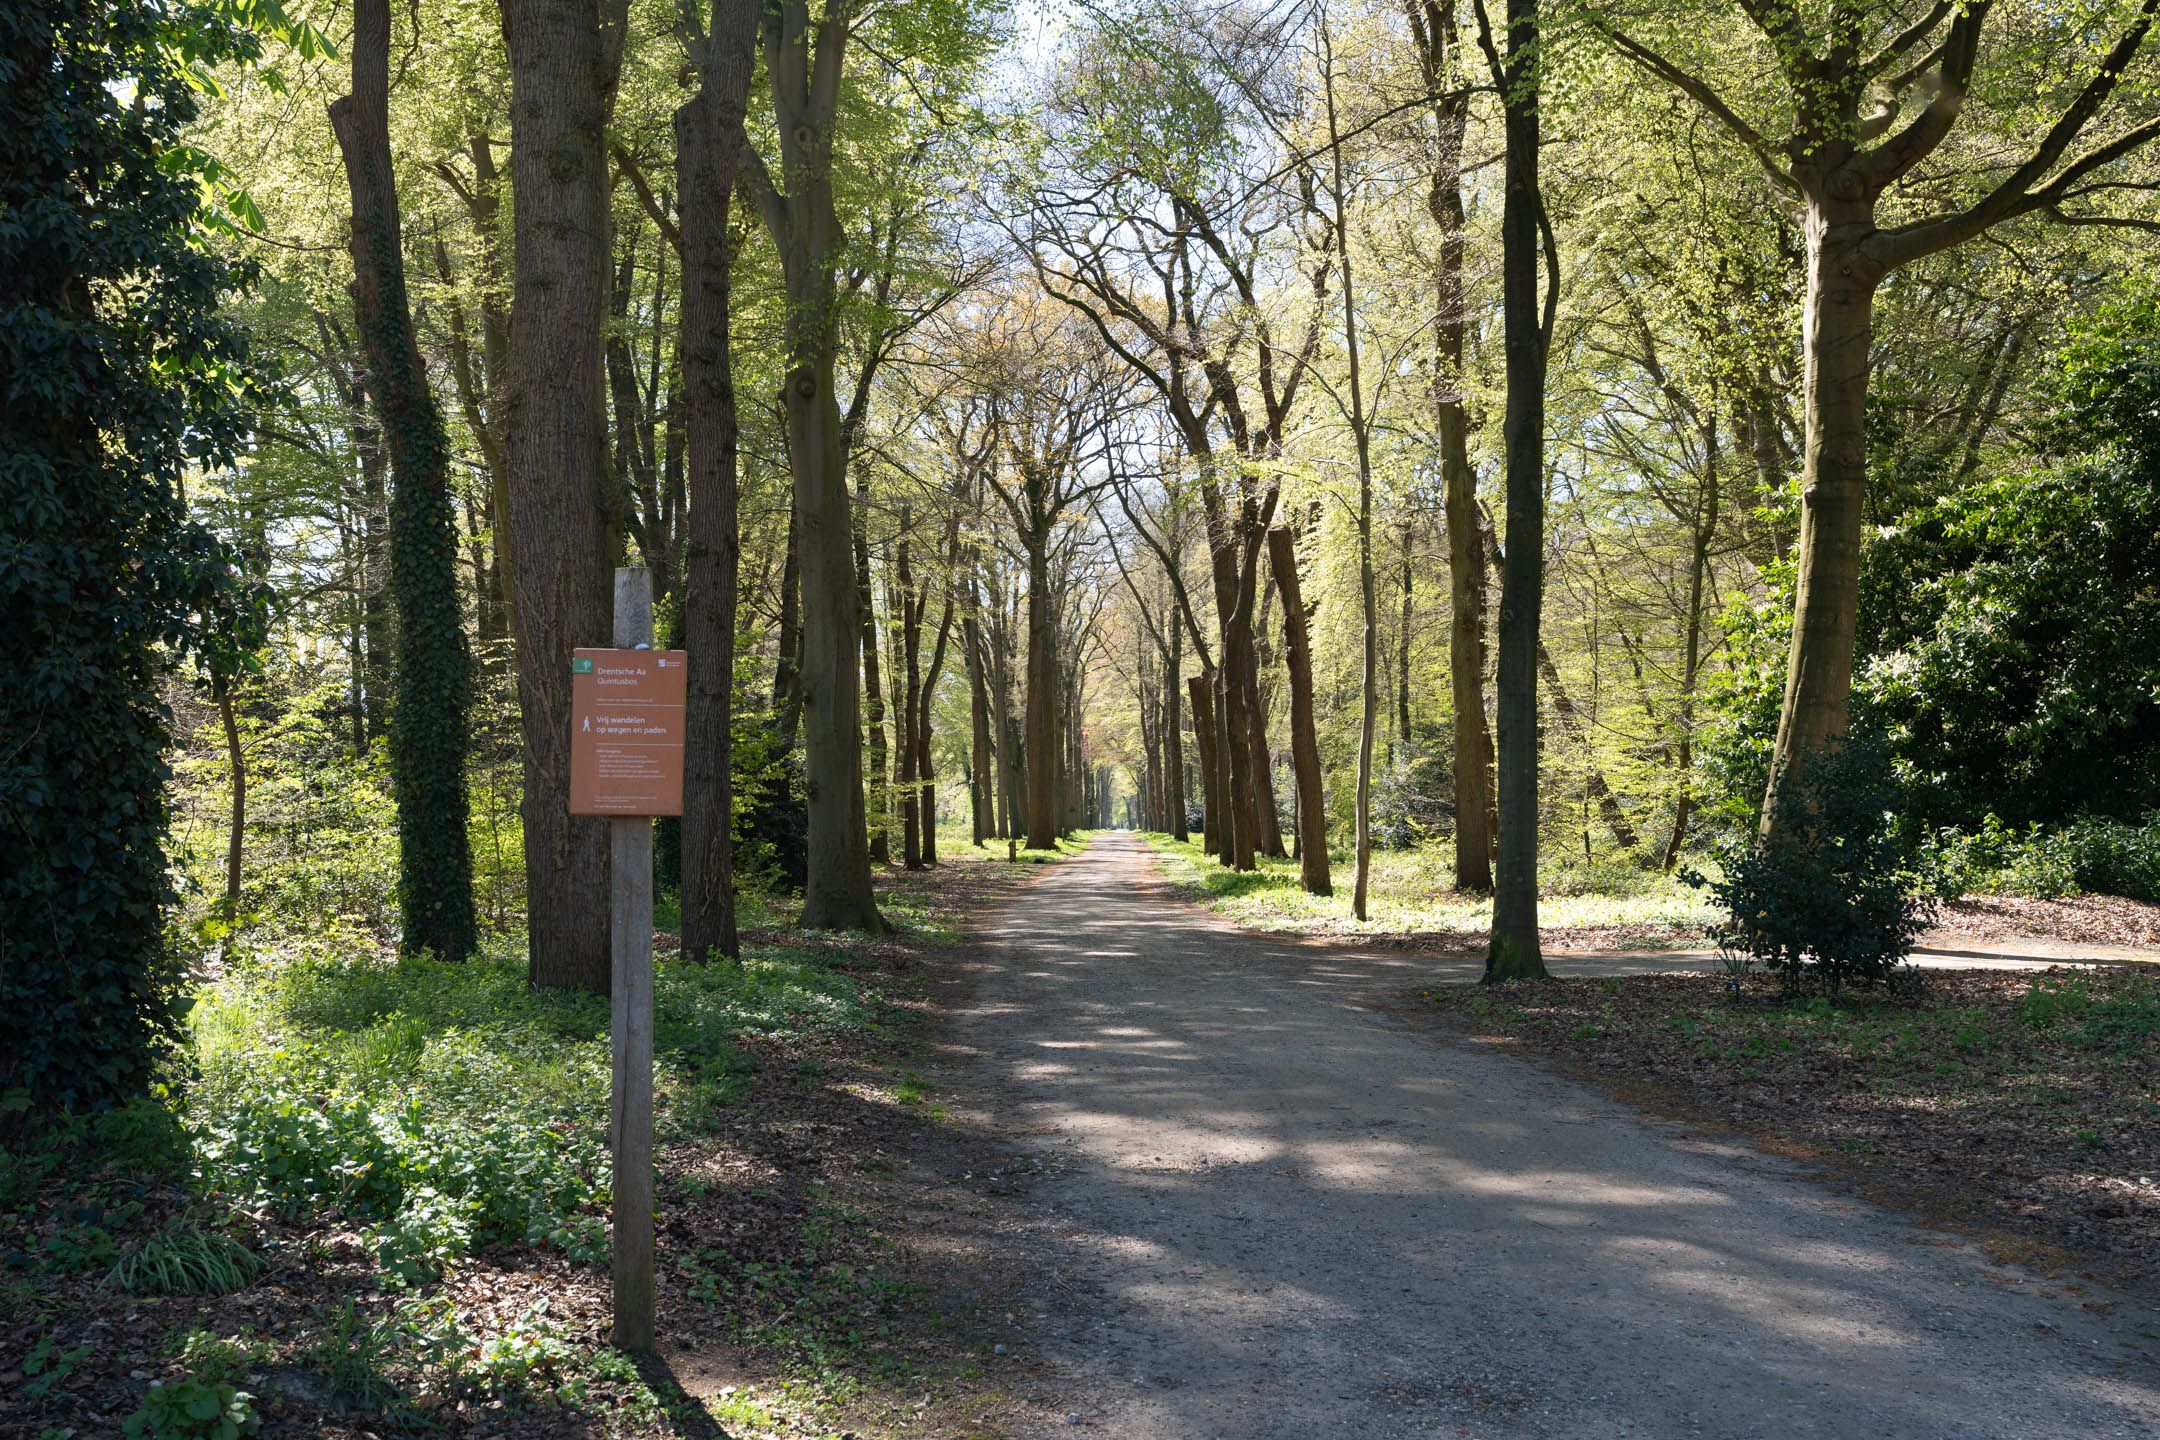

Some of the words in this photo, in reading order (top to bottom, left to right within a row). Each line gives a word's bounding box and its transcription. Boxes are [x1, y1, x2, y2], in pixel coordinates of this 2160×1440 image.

[597, 667, 635, 676] Drentsche
[636, 668, 647, 676] Aa
[596, 716, 609, 725] Vrij
[610, 716, 645, 724] wandelen
[643, 727, 666, 735] paden
